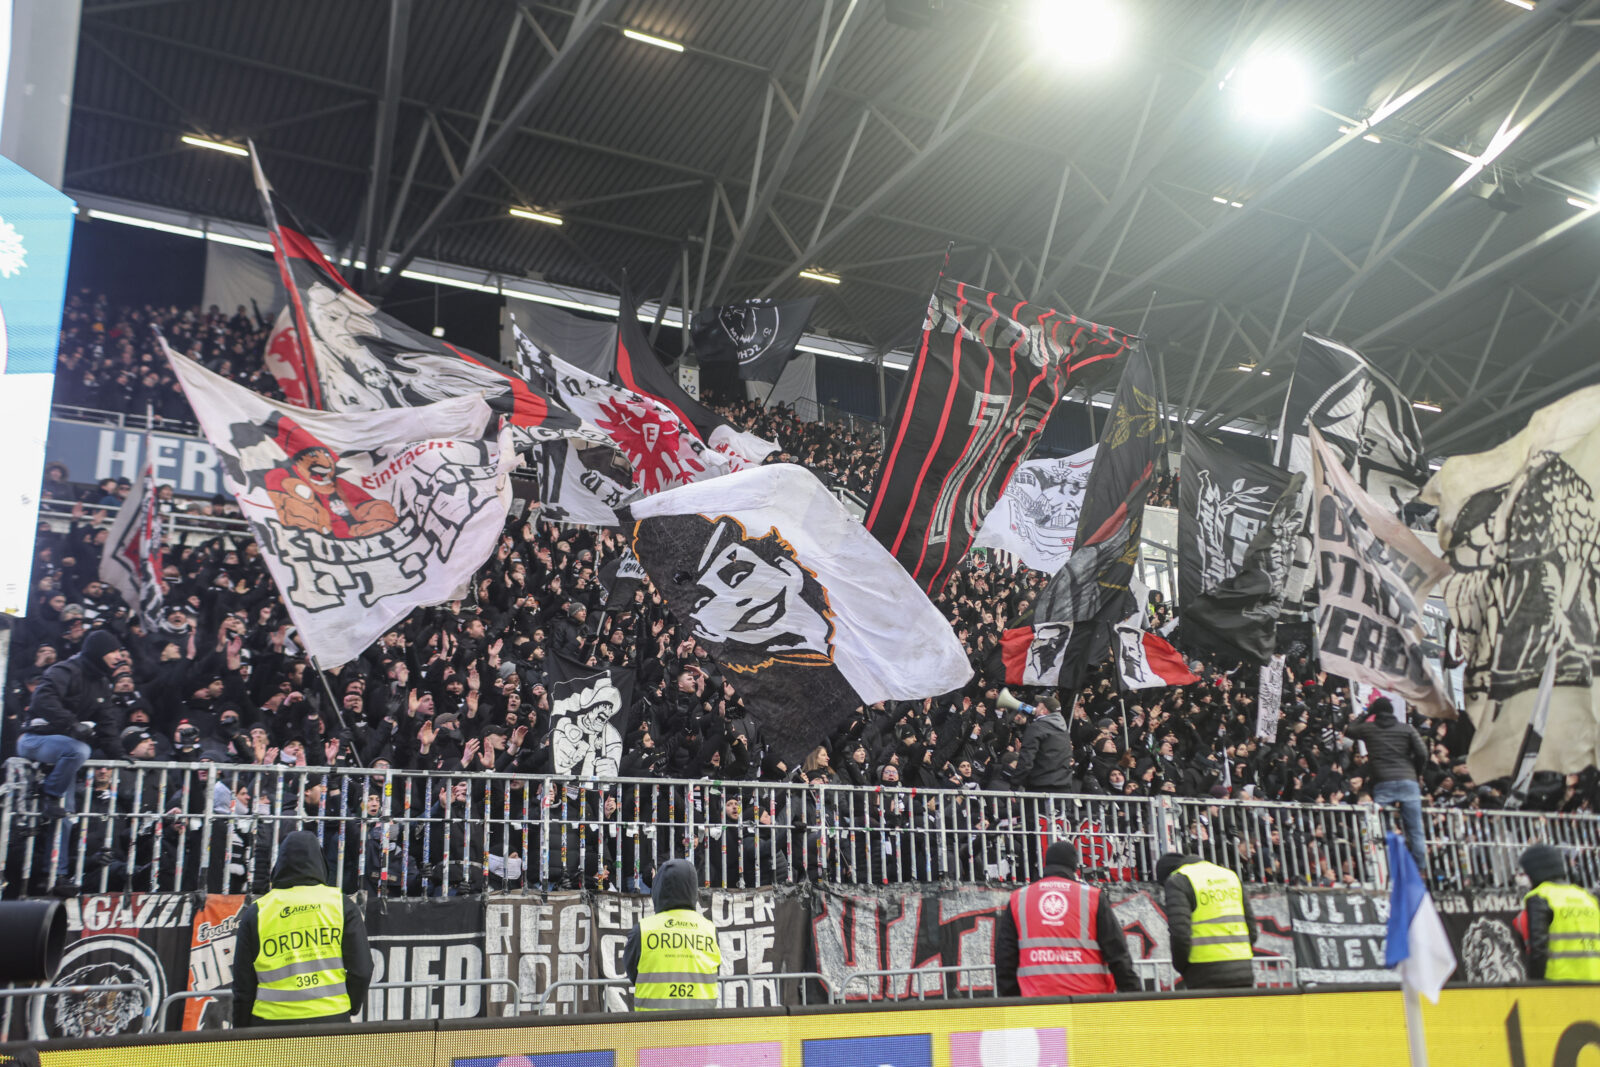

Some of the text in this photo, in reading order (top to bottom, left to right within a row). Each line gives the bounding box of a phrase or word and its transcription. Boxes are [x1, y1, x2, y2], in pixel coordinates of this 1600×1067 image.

[361, 440, 455, 490] Eintracht
[1199, 888, 1242, 906] ORDNE
[1300, 893, 1391, 923] ULTR
[1473, 894, 1526, 912] IMME
[486, 904, 592, 954] REG
[263, 927, 341, 957] ORDNER
[647, 932, 714, 953] ORDNER
[1317, 937, 1387, 968] NEV
[1030, 949, 1083, 963] ORDNER
[295, 974, 319, 988] 396
[489, 953, 590, 1003] ION
[669, 983, 694, 998] 262
